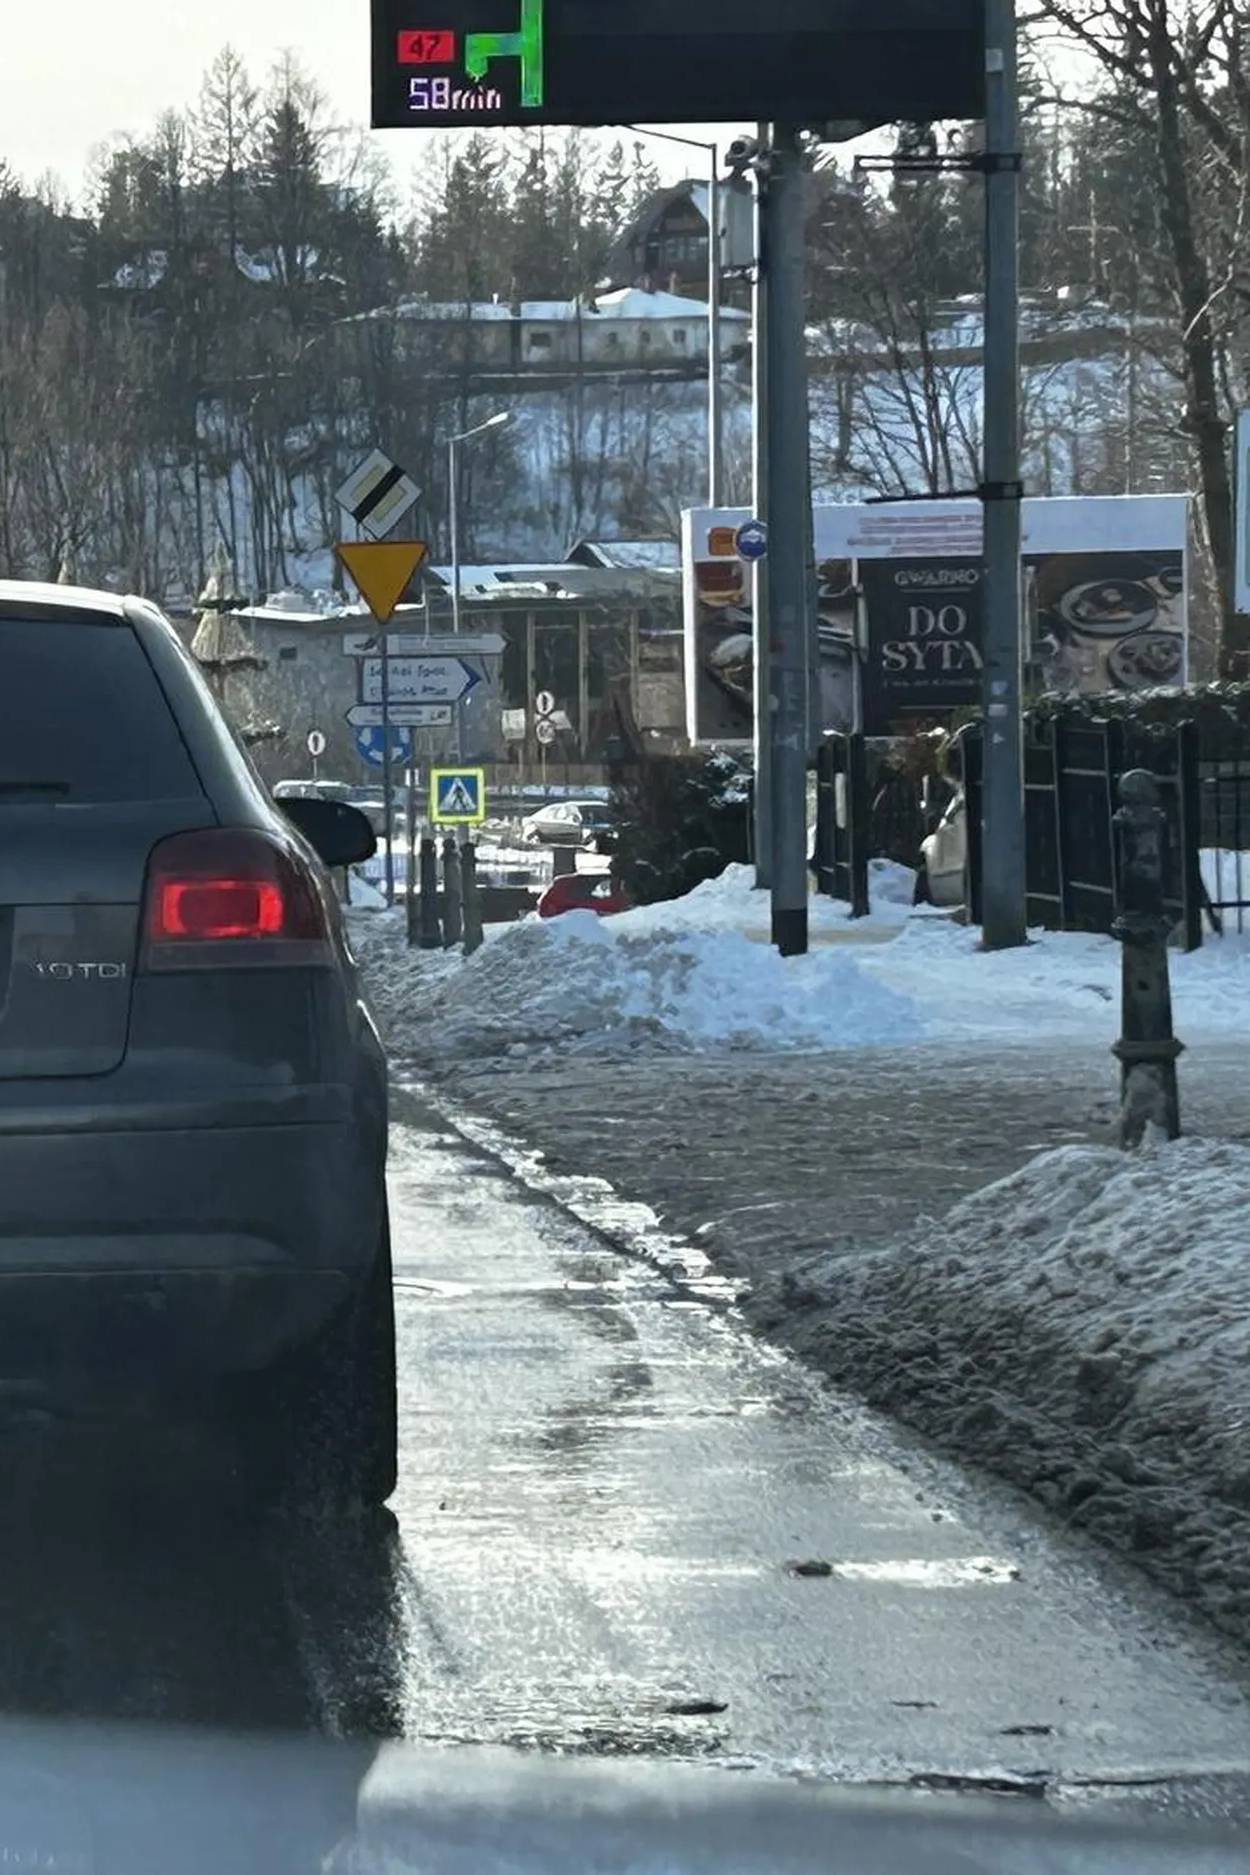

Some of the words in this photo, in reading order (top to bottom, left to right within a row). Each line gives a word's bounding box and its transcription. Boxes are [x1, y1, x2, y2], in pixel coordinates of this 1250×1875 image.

[409, 34, 441, 60] 47
[908, 605, 967, 636] DO
[882, 640, 984, 672] SYTA
